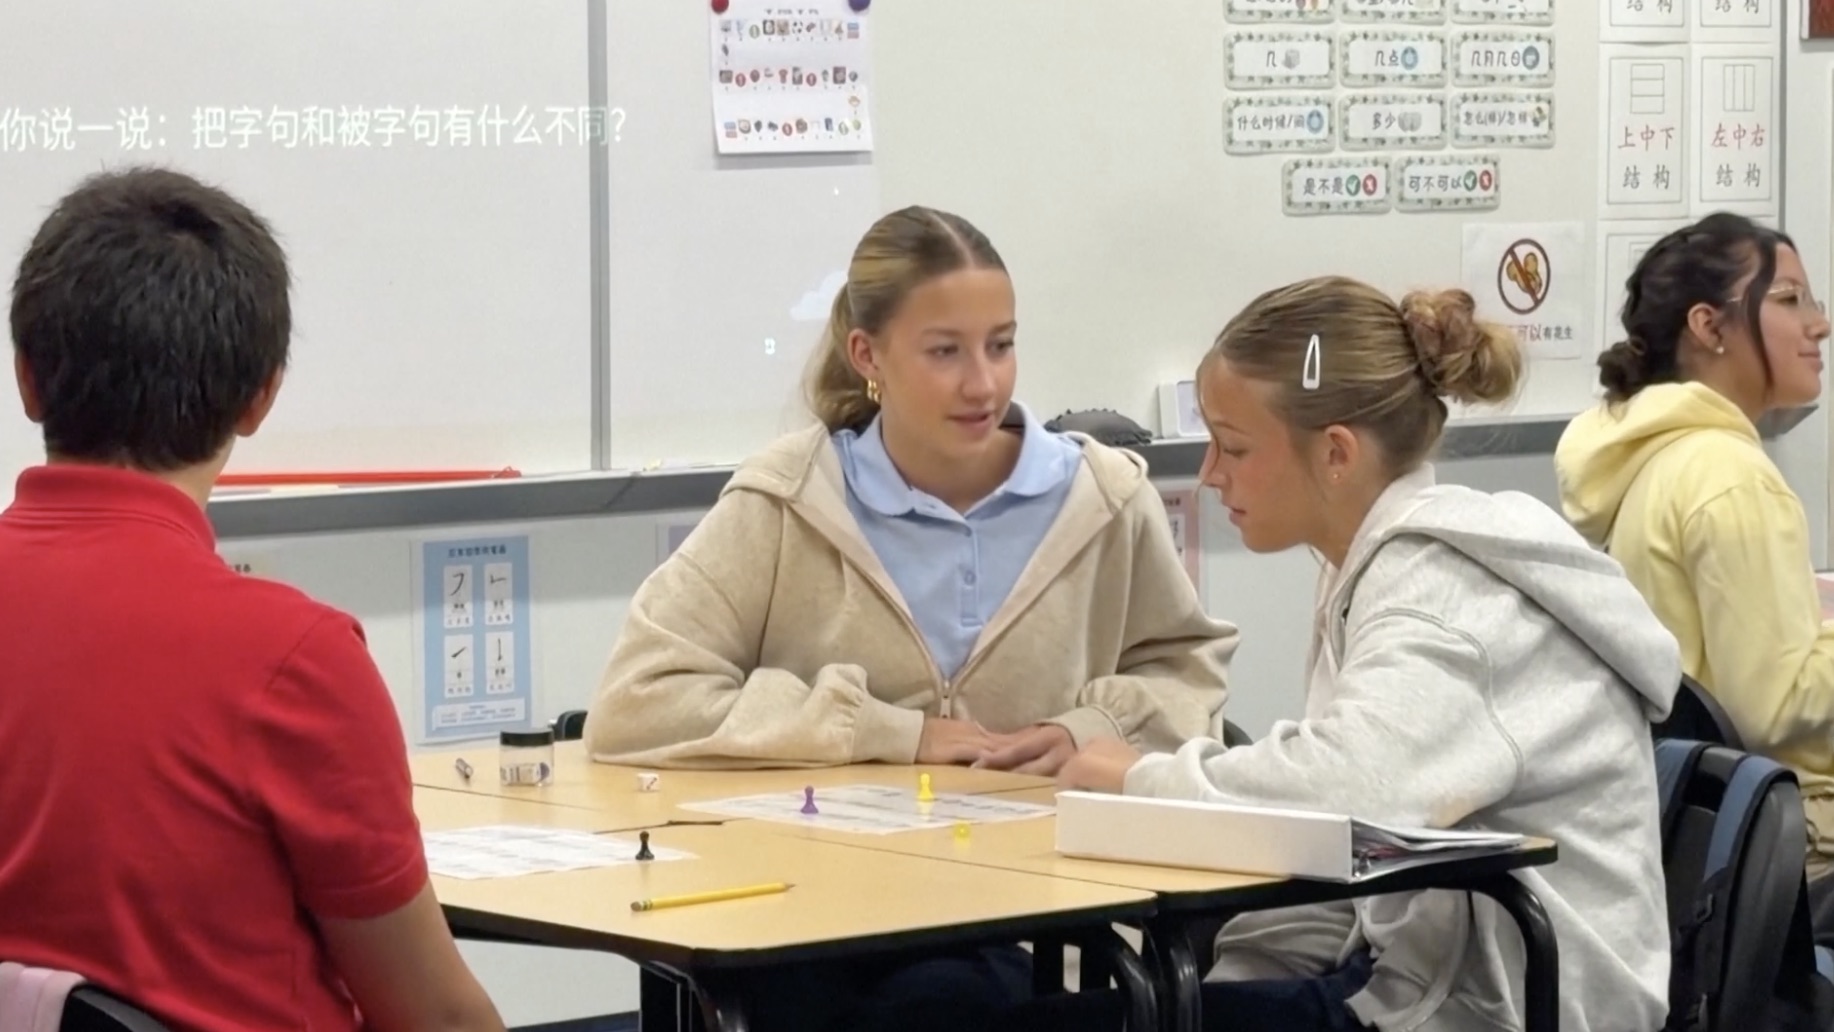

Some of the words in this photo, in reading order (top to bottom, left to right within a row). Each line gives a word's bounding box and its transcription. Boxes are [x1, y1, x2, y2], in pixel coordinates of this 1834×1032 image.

[1265, 50, 1277, 68] 几
[1374, 48, 1399, 67] 几点
[1471, 50, 1521, 67] 几月几日
[1372, 111, 1396, 130] 多少
[1618, 124, 1675, 151] 上中下
[1711, 122, 1765, 150] 左中右
[1408, 175, 1462, 193] 可不可以
[1622, 164, 1671, 190] 结构
[1715, 163, 1761, 188] 结构
[1303, 177, 1344, 196] 是不是
